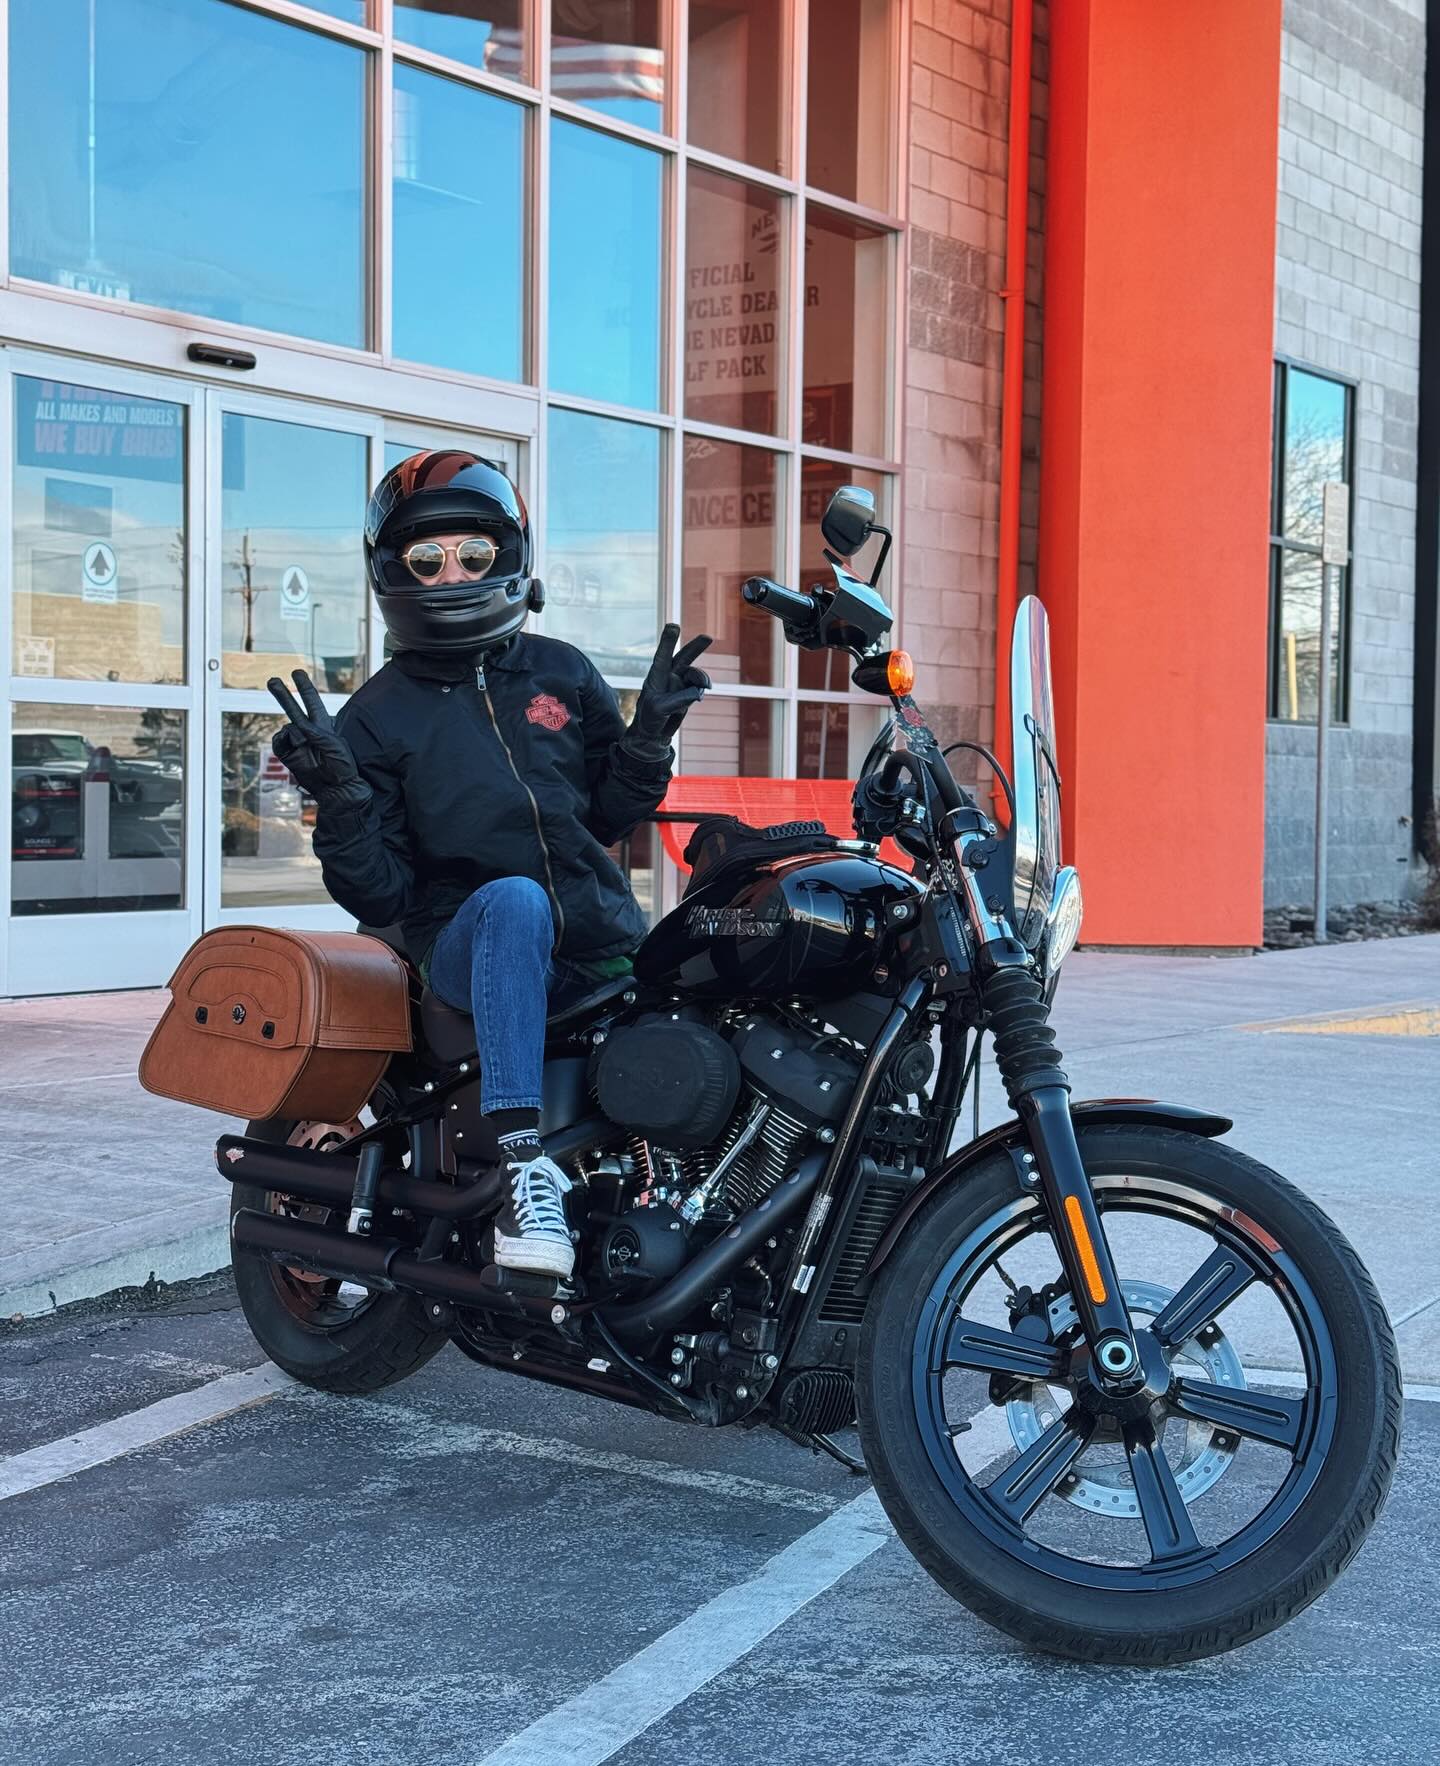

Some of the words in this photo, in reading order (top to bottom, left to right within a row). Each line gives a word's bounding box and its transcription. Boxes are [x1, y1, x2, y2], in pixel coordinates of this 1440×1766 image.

[711, 322, 776, 349] NEVAD
[716, 355, 766, 379] PACK
[36, 401, 56, 420] ALL
[60, 403, 100, 422] MAKES
[103, 405, 126, 424] AND
[129, 407, 174, 425] MODELS
[35, 421, 68, 453] WE
[74, 423, 115, 456] BUY
